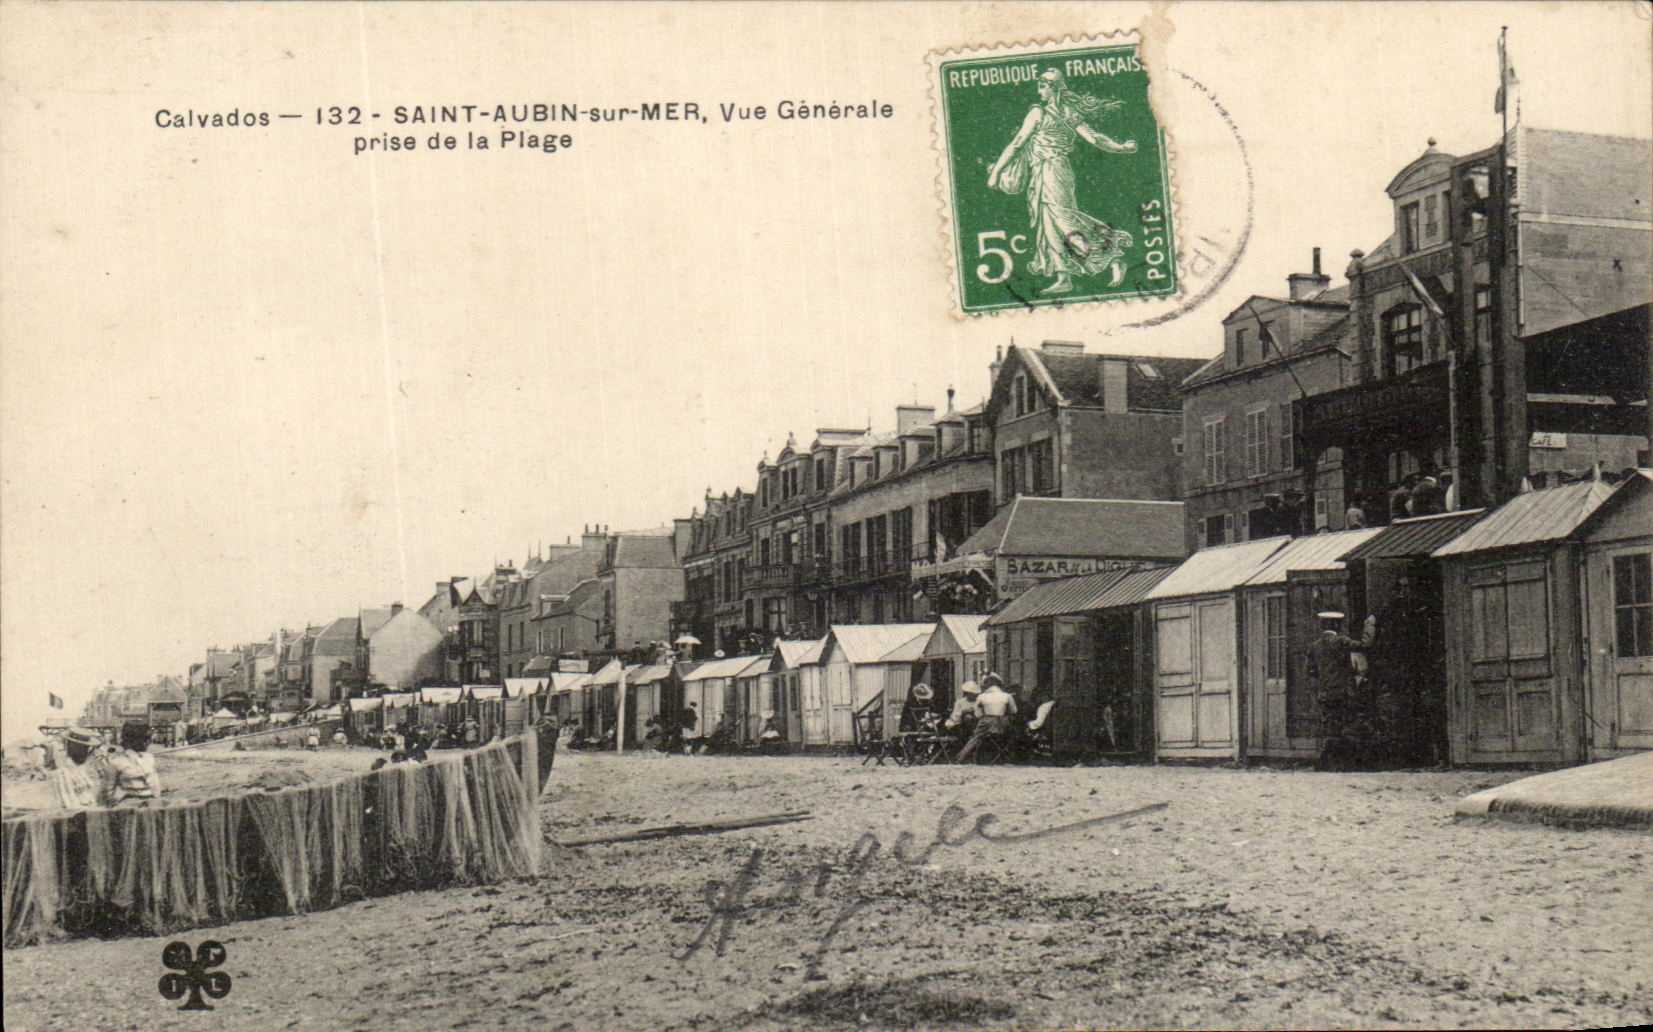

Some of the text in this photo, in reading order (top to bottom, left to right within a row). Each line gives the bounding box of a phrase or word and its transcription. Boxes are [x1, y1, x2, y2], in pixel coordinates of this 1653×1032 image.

[1064, 55, 1147, 77] FRANÇAIS
[1141, 199, 1168, 280] POSTES
[1007, 558, 1068, 574] BAZAR
